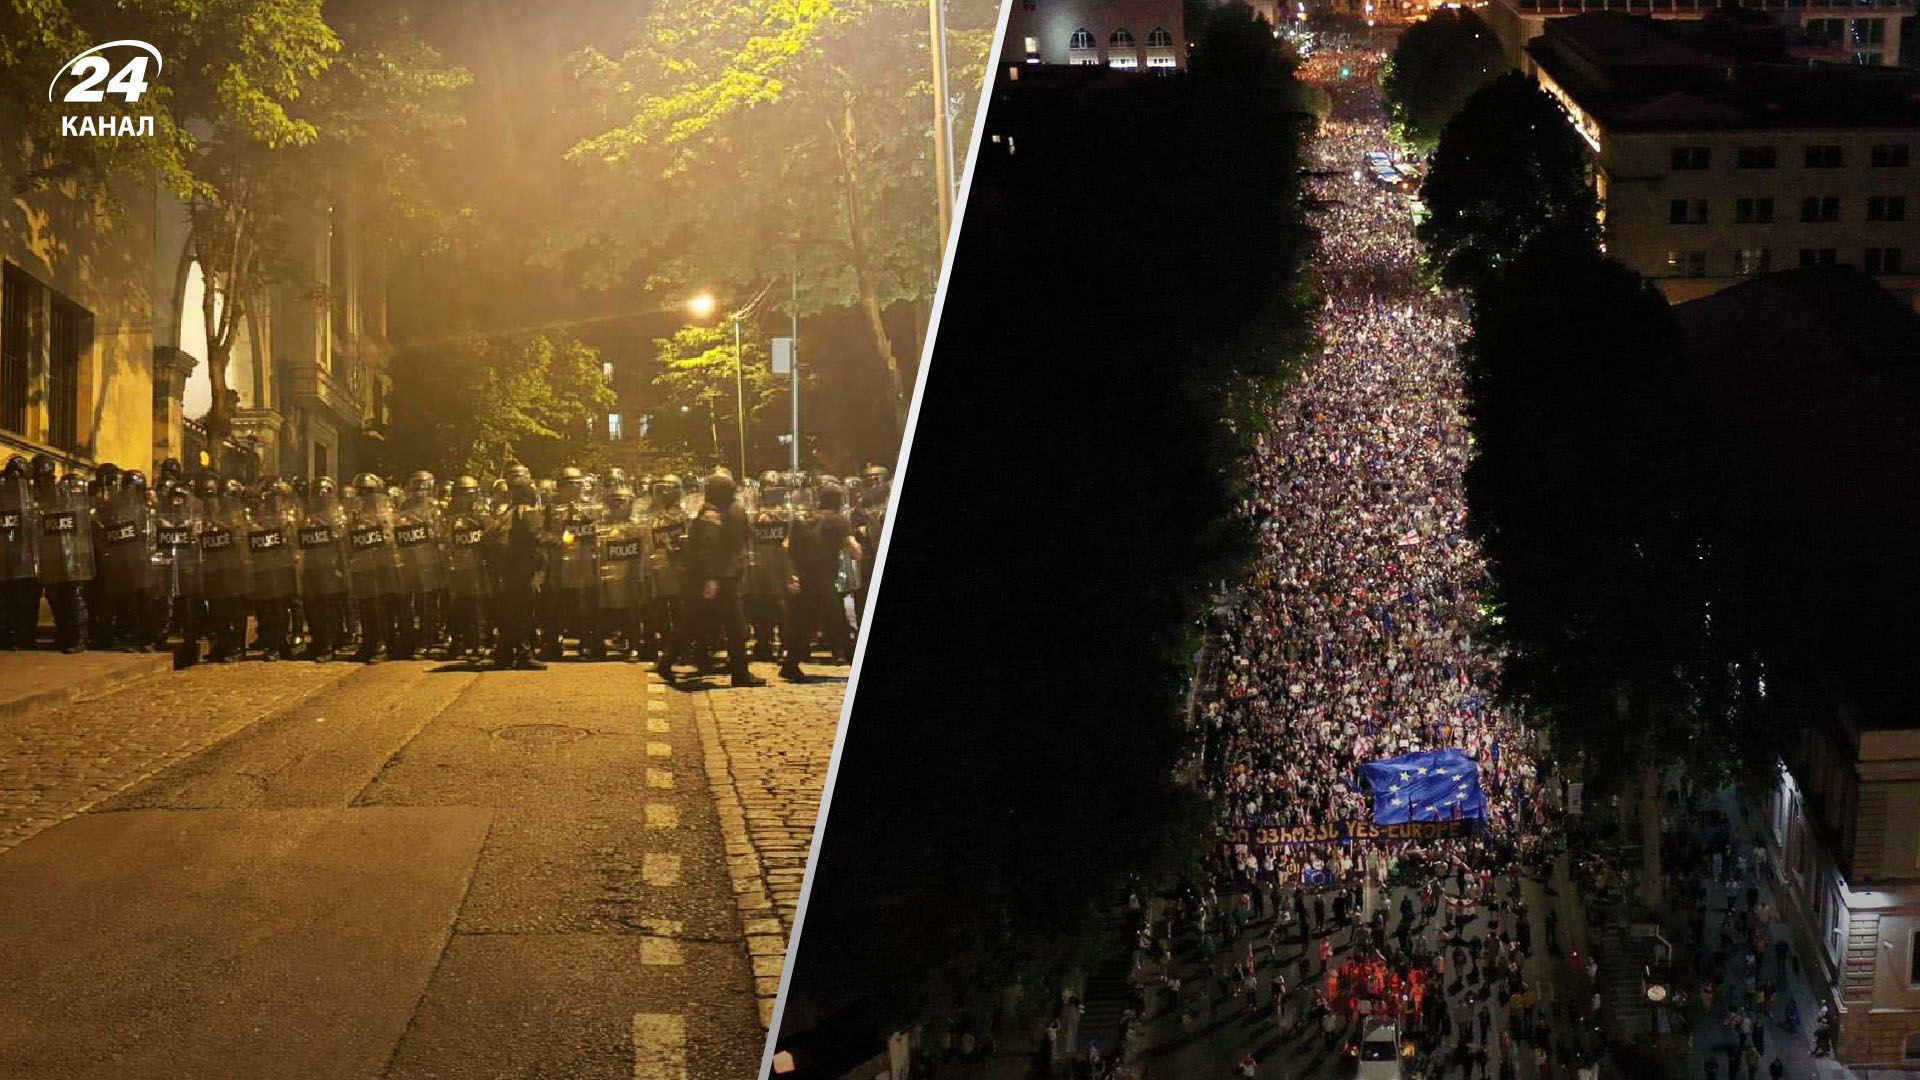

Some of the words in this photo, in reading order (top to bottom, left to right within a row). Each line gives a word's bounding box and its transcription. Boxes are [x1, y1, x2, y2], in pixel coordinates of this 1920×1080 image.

[107, 525, 135, 542] POLICE
[160, 531, 187, 544] POLICE
[252, 532, 280, 547] POLICE
[302, 530, 329, 545] POLICE
[353, 530, 382, 546] POLICE
[398, 526, 425, 543] POLICE
[755, 525, 784, 539] POLICE
[203, 532, 230, 548] POLICE
[609, 543, 639, 557] POLICE
